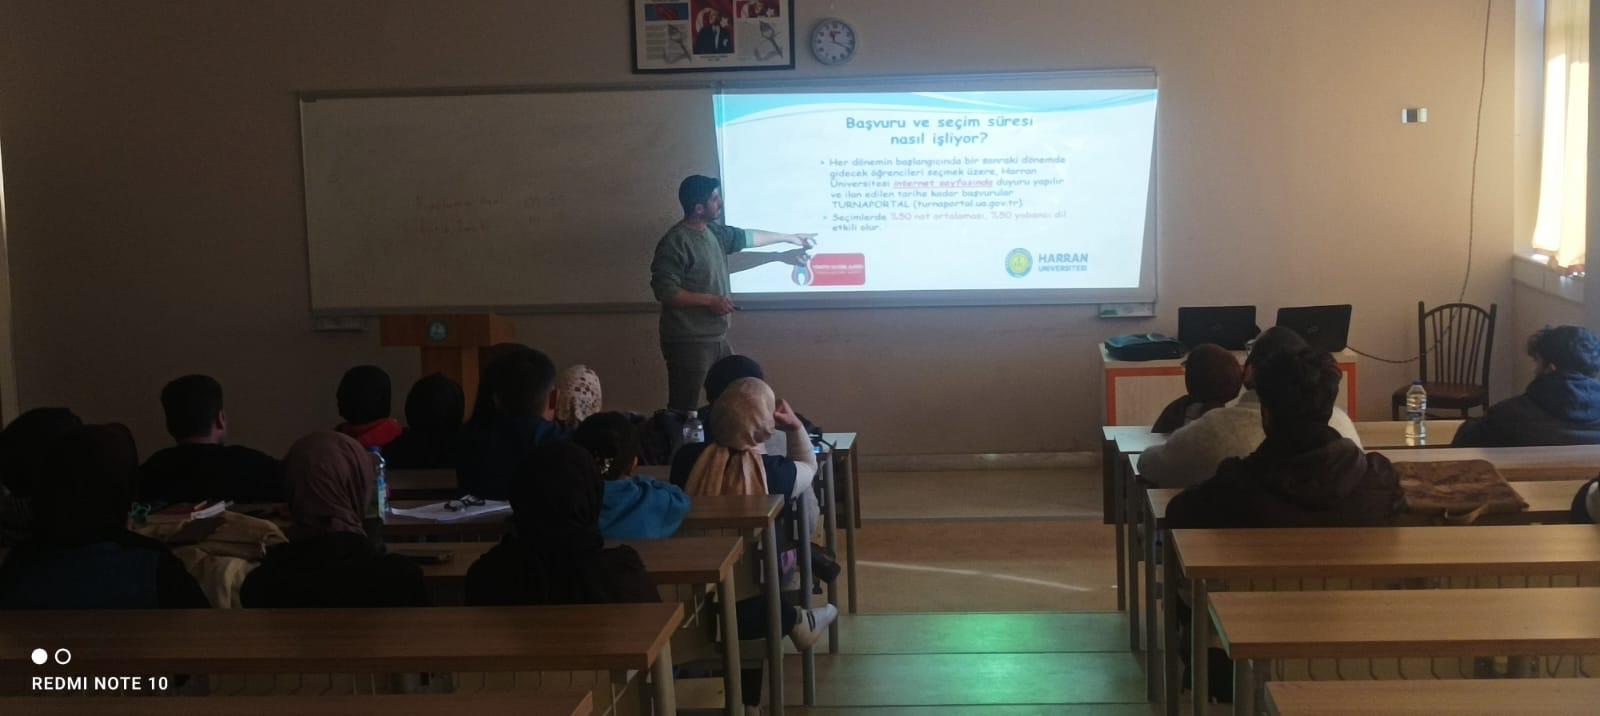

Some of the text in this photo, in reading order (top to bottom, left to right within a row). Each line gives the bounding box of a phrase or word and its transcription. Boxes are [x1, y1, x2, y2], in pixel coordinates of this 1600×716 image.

[846, 117, 906, 131] Başvuru
[913, 119, 930, 128] ve
[938, 117, 980, 130] seçim
[891, 132, 988, 146] nasıl işliyor?
[829, 158, 849, 166] Her
[852, 157, 893, 166] dönemin
[964, 156, 979, 164] bir
[982, 156, 1018, 164] sonraki
[1021, 155, 1066, 164] dönemde
[830, 169, 868, 180] gidecek
[927, 168, 964, 177] seçmek
[996, 176, 1031, 186] duyuru
[931, 189, 959, 197] kadar
[832, 223, 857, 232] etkili
[1038, 252, 1088, 263] HARRAN
